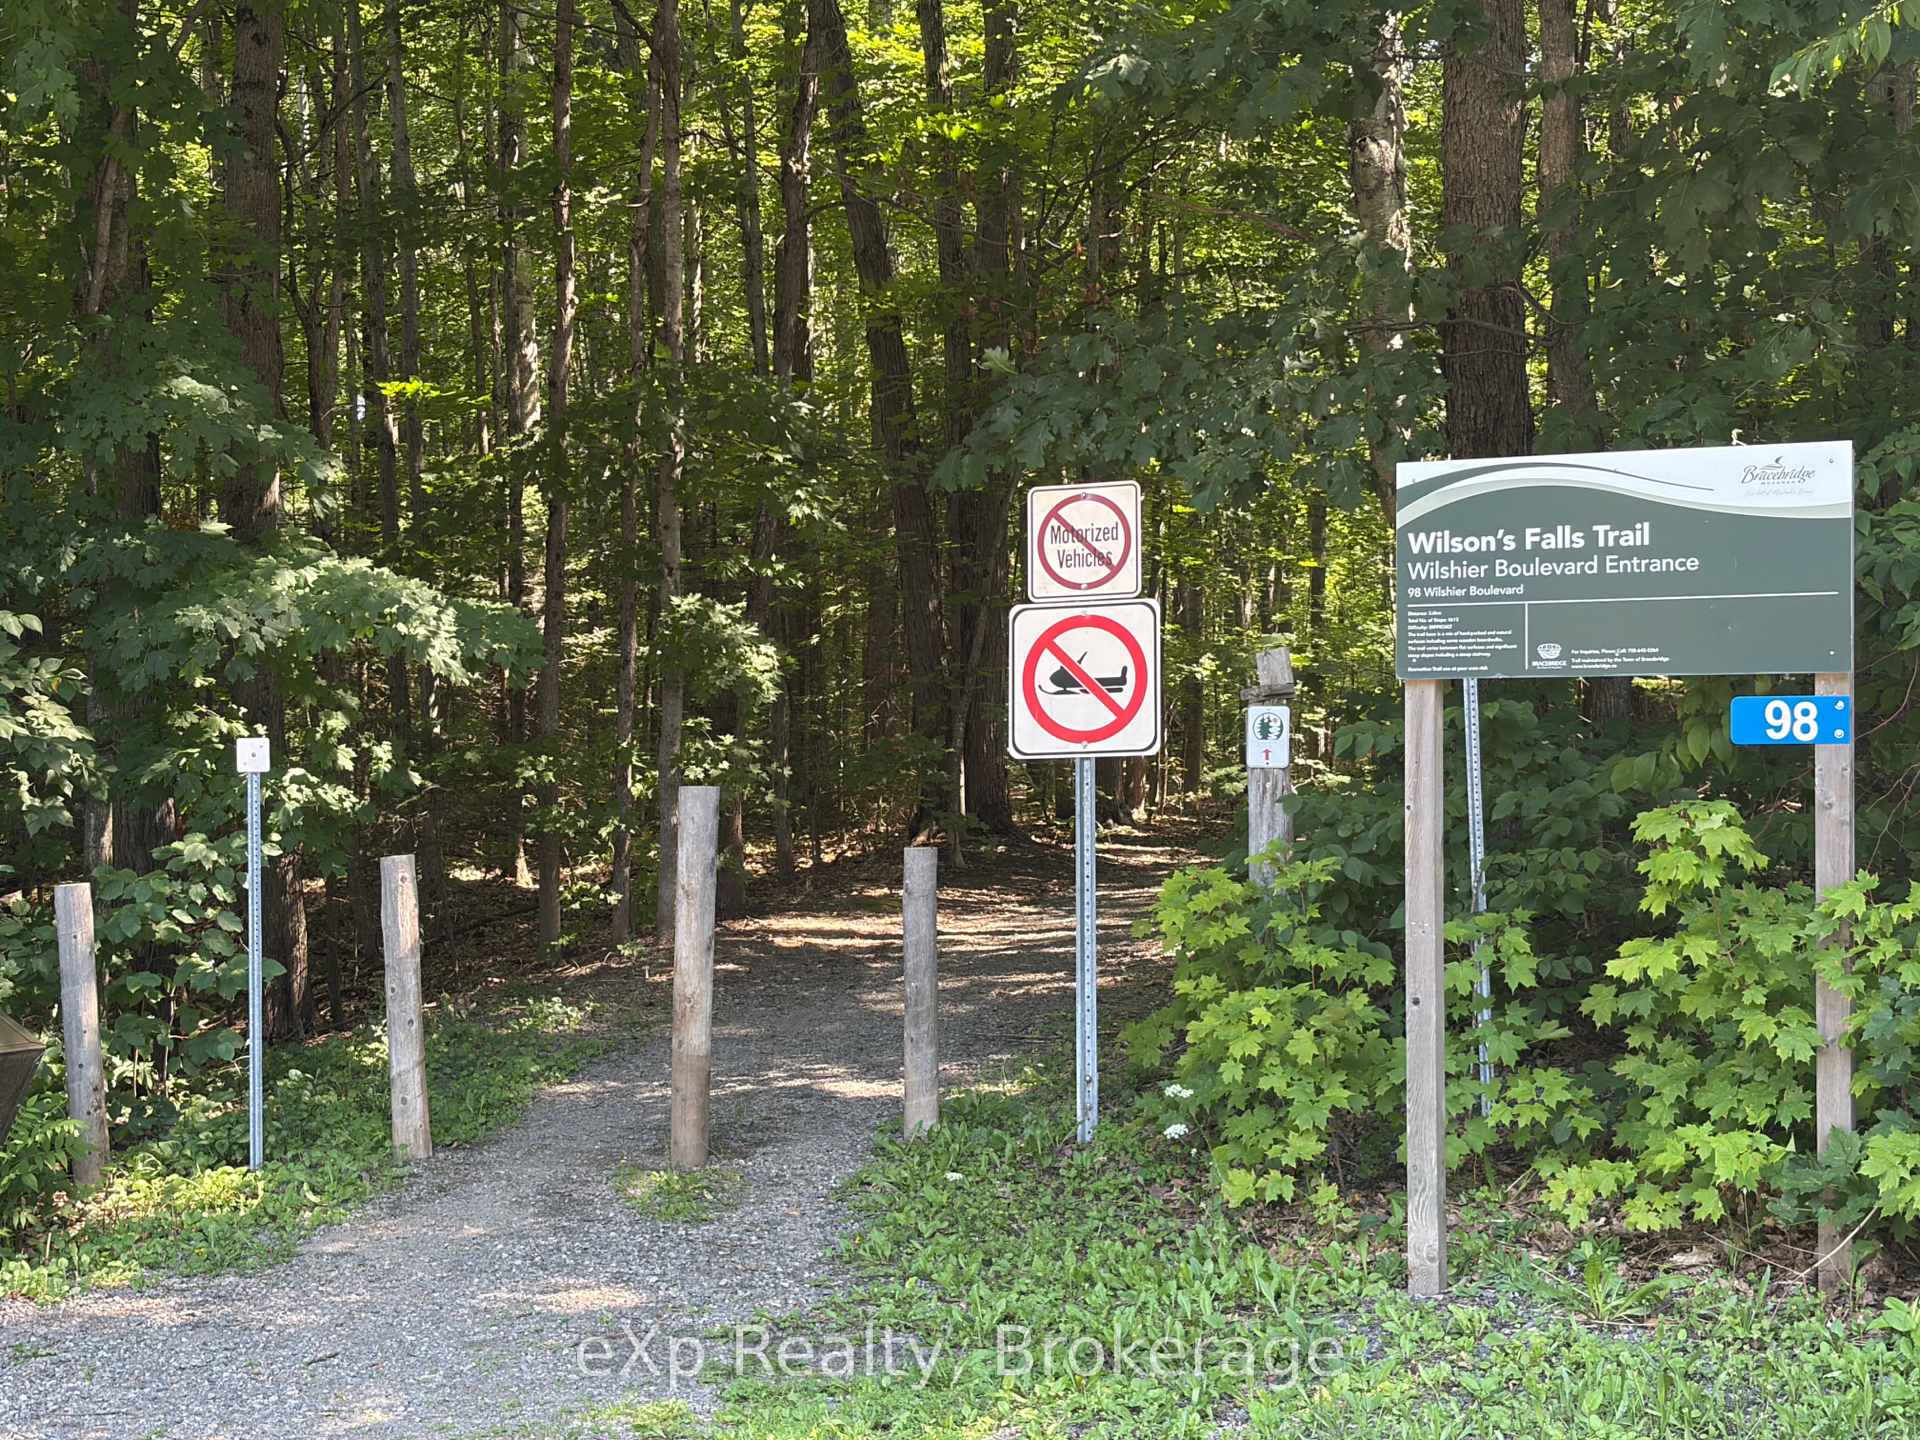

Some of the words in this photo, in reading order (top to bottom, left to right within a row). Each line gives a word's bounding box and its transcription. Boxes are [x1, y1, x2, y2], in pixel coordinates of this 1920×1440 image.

[1741, 464, 1816, 484] Bracebridge
[1050, 521, 1119, 545] Motorized
[1408, 529, 1517, 555] Wilson's
[1525, 524, 1586, 551] Falls
[1592, 521, 1650, 548] Trail
[1057, 548, 1113, 569] Vehicles
[1407, 560, 1489, 581] Wilshier
[1496, 554, 1599, 578] Boulevard
[1605, 554, 1700, 574] Entrance
[1407, 586, 1422, 599] 98
[1423, 585, 1468, 598] Wilshier
[1470, 583, 1524, 597] Boulevard
[1765, 699, 1818, 742] 98
